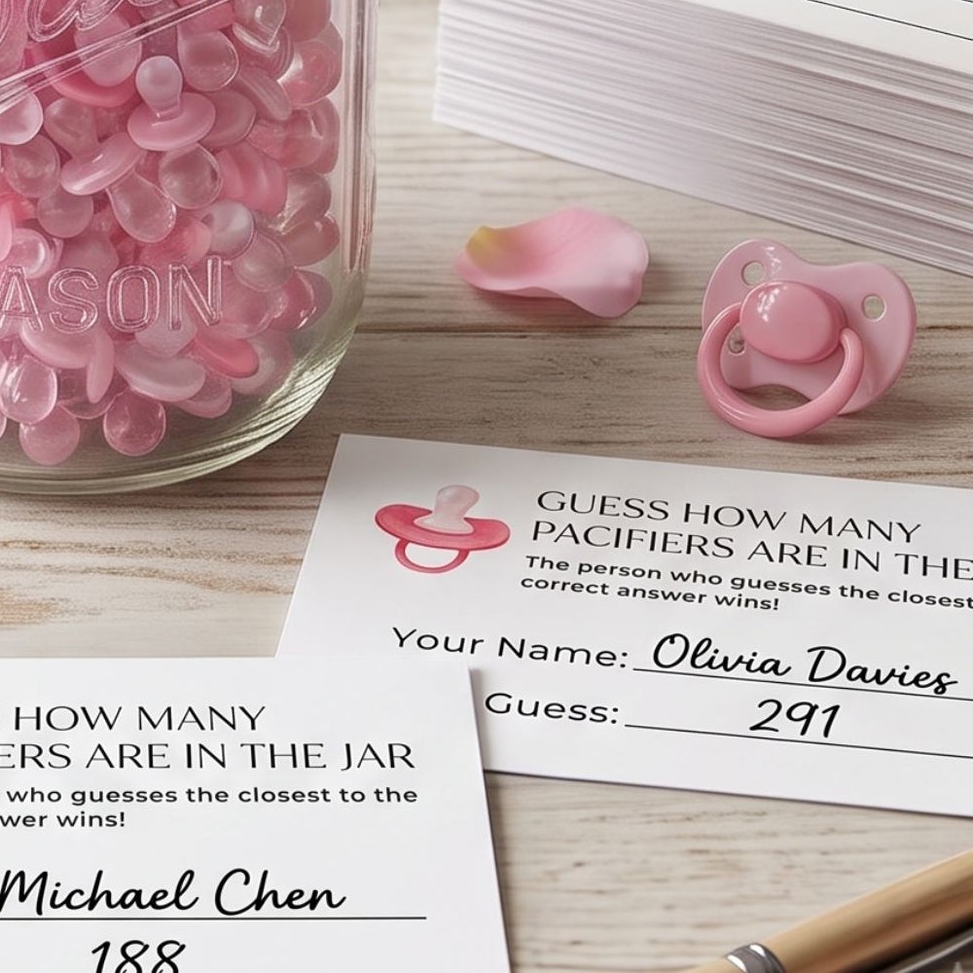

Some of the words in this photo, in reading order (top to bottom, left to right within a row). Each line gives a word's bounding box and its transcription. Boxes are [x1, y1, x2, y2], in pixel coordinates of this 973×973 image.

[538, 491, 668, 520] GUESS
[684, 503, 786, 530] HOW
[800, 514, 921, 543] MANY
[533, 521, 734, 558] PACIFIERS
[747, 541, 827, 567] ARE
[843, 548, 879, 572] IN
[895, 553, 973, 580] THE
[521, 578, 609, 595] correct
[617, 587, 707, 603] answer
[715, 593, 779, 610] wins!
[526, 556, 569, 571] The
[578, 563, 661, 579] person
[670, 570, 722, 585] who
[731, 578, 830, 595] guesses
[839, 585, 879, 600] the
[888, 590, 973, 609] closest
[393, 627, 484, 654] Your
[498, 637, 627, 668] Name:
[652, 632, 791, 678] Olivia
[806, 645, 959, 697] Davies
[15, 706, 122, 731] HOW
[138, 706, 265, 731] MANY
[485, 693, 618, 724] Guess:
[749, 698, 841, 739] 291
[86, 743, 170, 768] ARE
[186, 743, 226, 768] IN
[240, 743, 326, 768] THE
[341, 743, 415, 771] JAR
[6, 787, 61, 802] who
[71, 791, 177, 806] guesses
[186, 787, 229, 803] the
[238, 787, 331, 803] closest
[339, 789, 365, 802] to
[374, 787, 417, 802] the
[56, 811, 124, 827] wins!
[214, 867, 346, 916] Chen
[91, 940, 187, 973] 188
